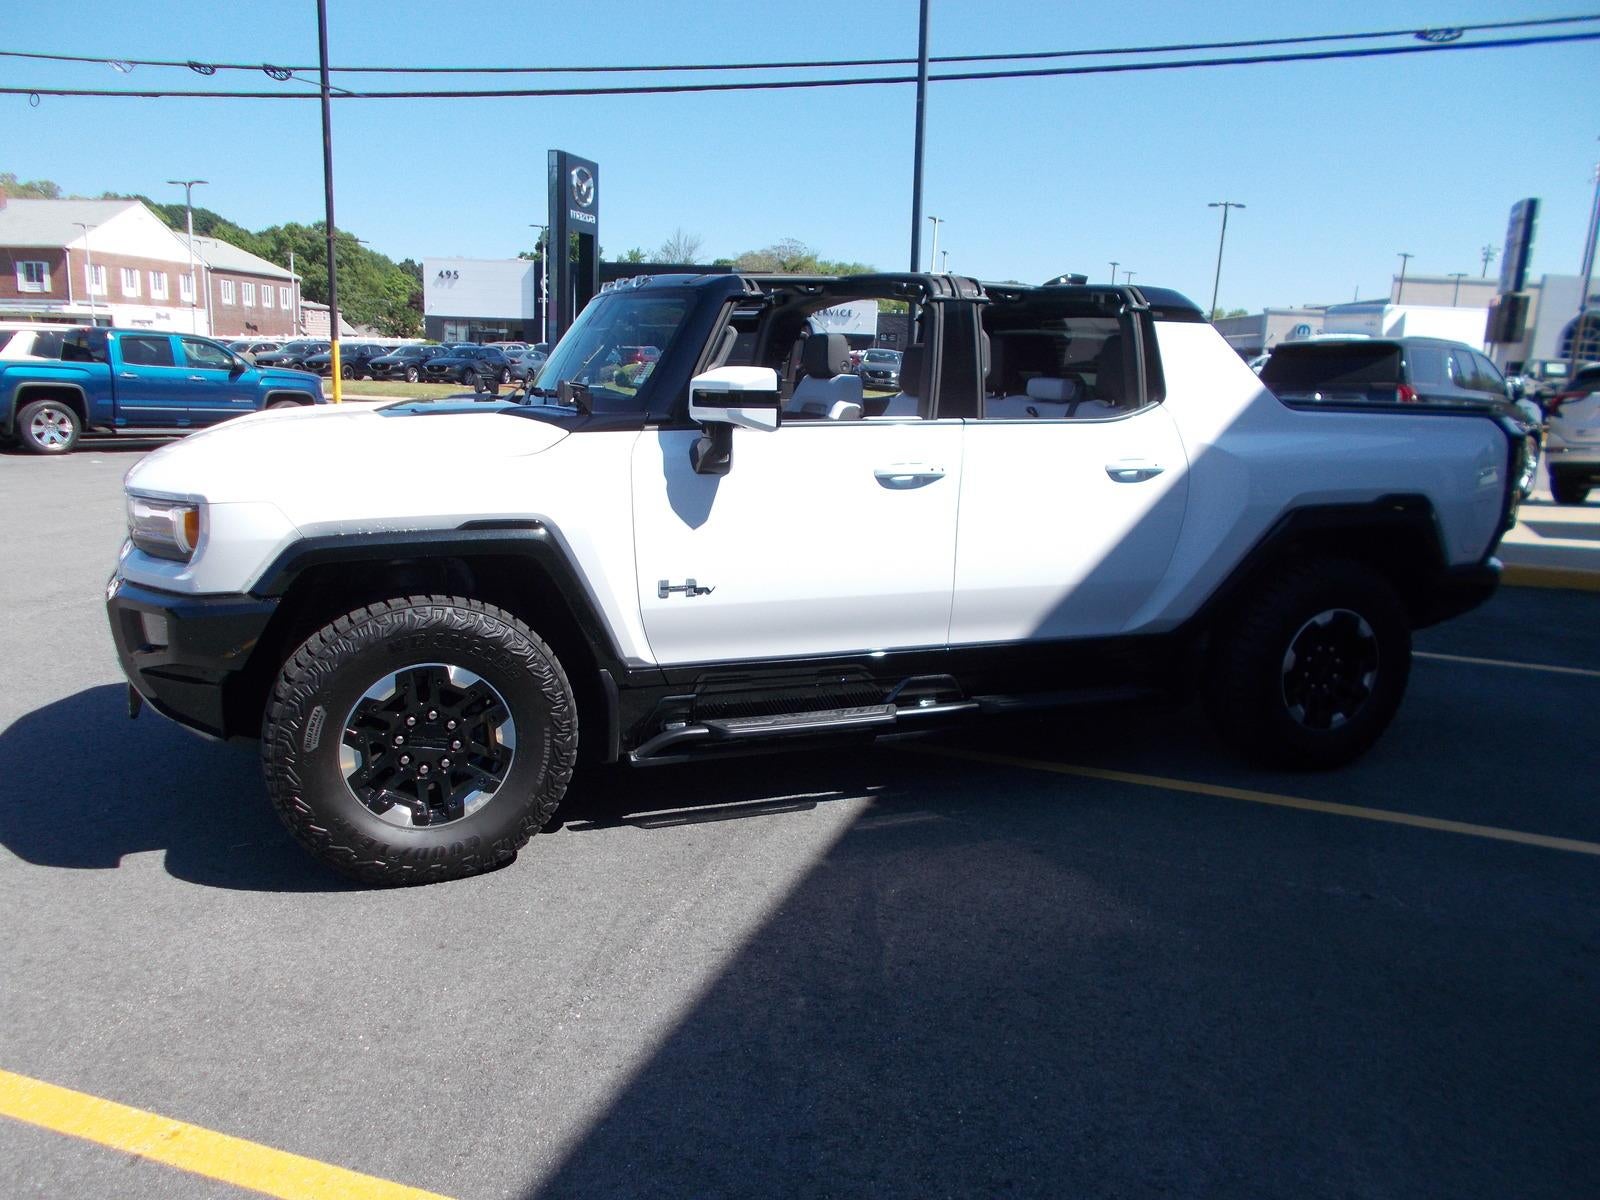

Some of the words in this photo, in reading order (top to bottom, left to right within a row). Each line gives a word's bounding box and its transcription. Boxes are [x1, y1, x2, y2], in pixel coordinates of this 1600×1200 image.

[570, 209, 596, 225] mazda
[438, 269, 459, 280] 495
[812, 308, 853, 318] ERVICE
